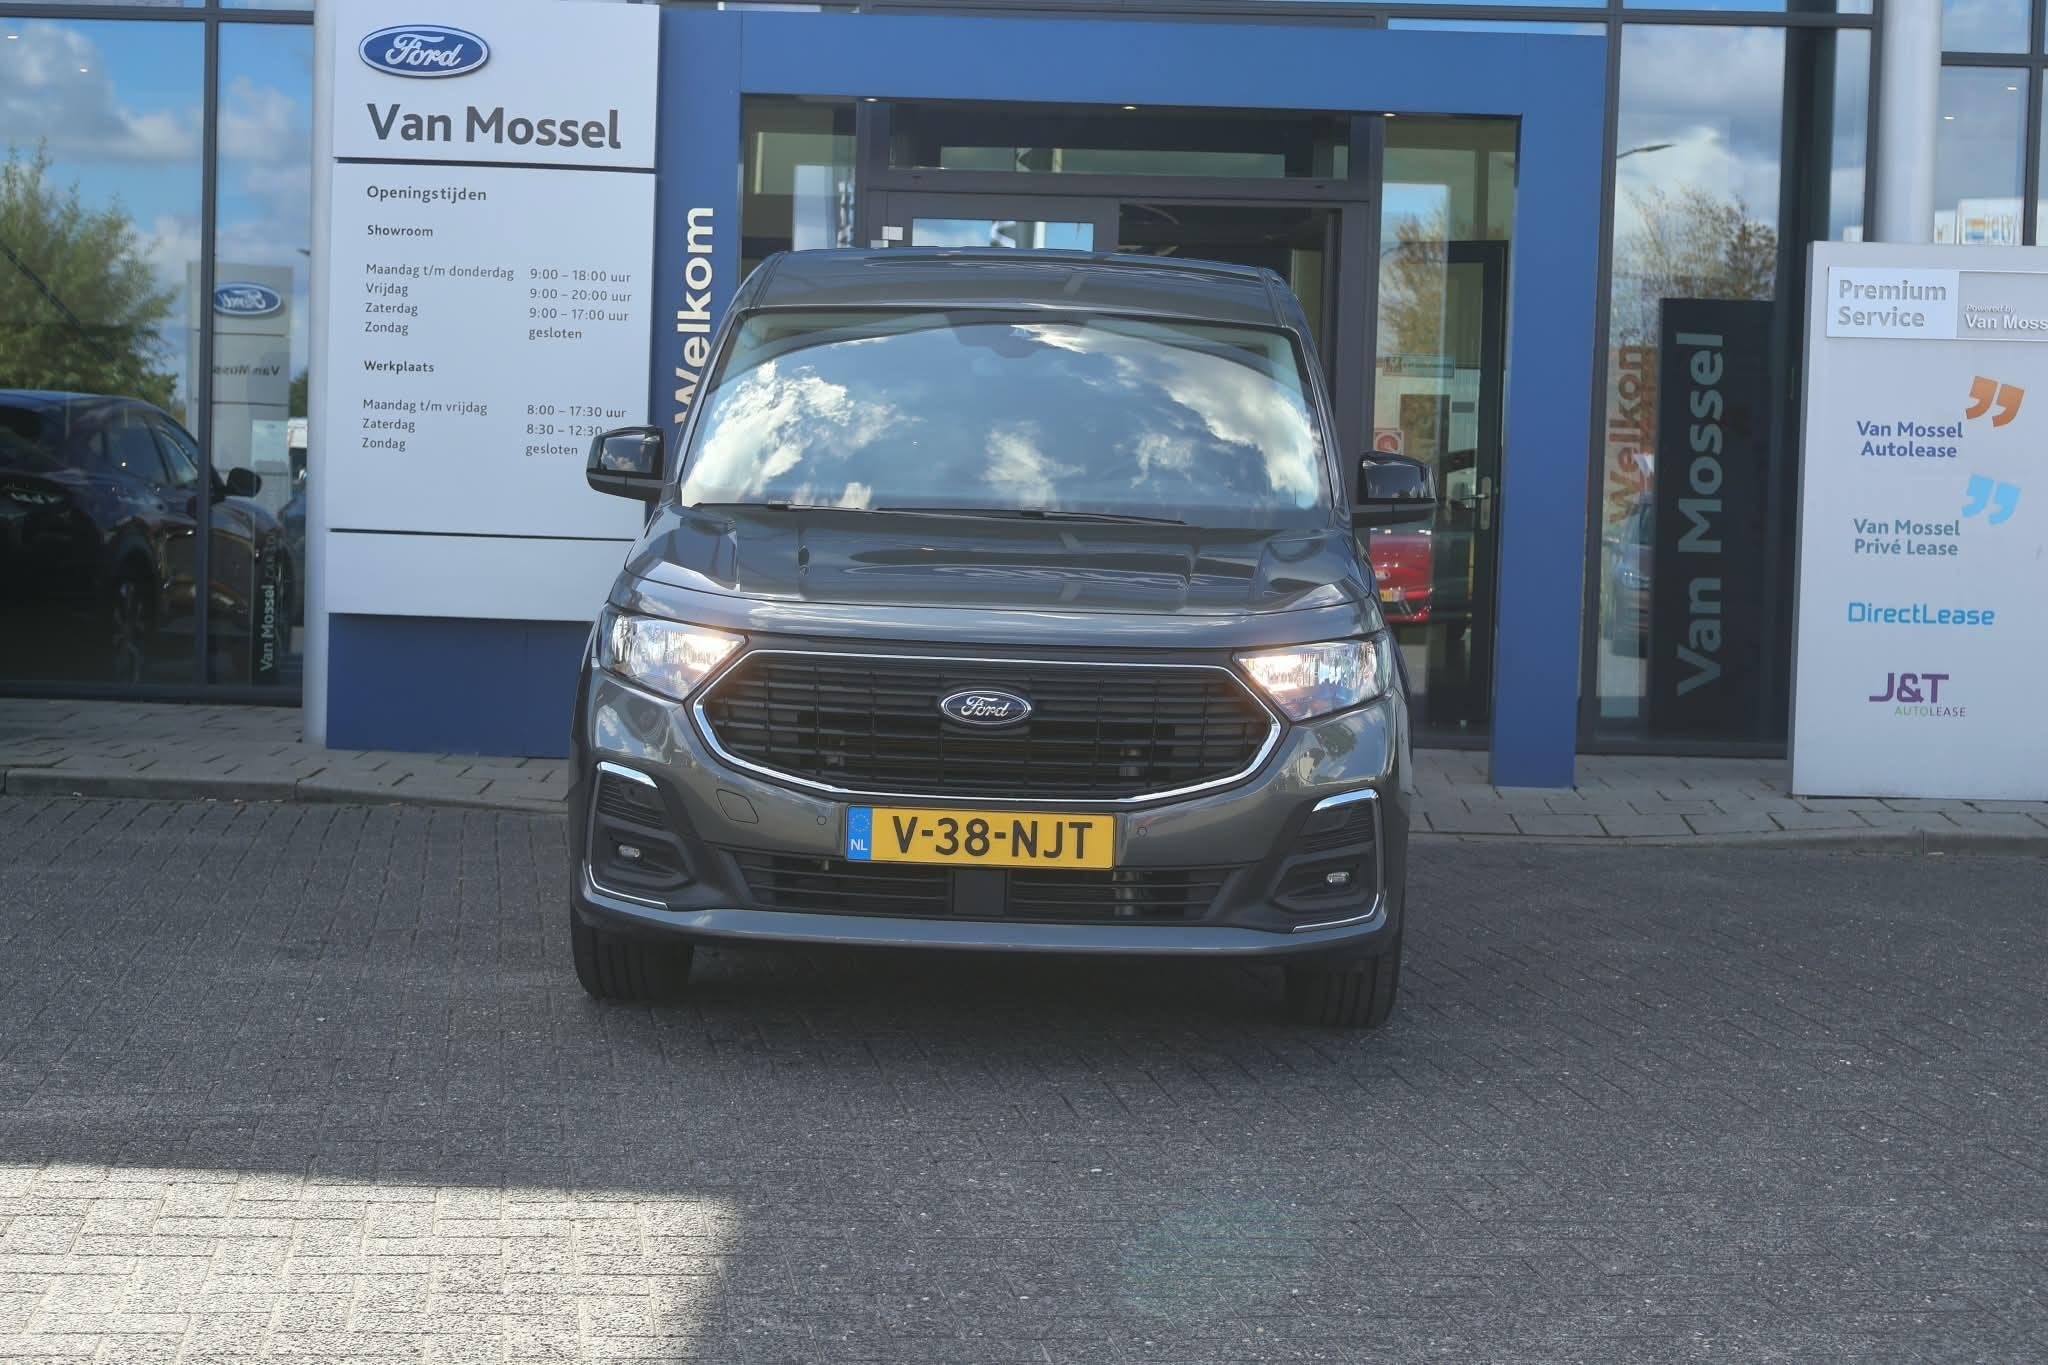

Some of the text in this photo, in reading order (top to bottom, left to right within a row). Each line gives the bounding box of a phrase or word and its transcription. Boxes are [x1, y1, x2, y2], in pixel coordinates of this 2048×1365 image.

[384, 33, 464, 66] Ford
[366, 103, 622, 149] Van Mossel
[366, 185, 487, 204] Openingstijden
[366, 224, 434, 237] Showroom
[365, 263, 420, 279] Maandag
[423, 265, 446, 277] t/m
[449, 266, 514, 282] donderdag
[530, 268, 559, 281] 9:00
[572, 269, 607, 283] 18:00
[611, 273, 632, 283] uur
[365, 283, 409, 298] Vrijdag
[529, 288, 558, 300] 9:00
[571, 290, 608, 302] 20:00
[611, 292, 632, 303] uur
[1838, 279, 1947, 301] Premium
[365, 302, 419, 317] Zaterdag
[528, 307, 557, 320] 9:00
[570, 308, 605, 322] 17:00
[608, 312, 630, 322] uur
[1837, 305, 1926, 328] Service
[1965, 313, 2048, 330] Van Moss
[364, 321, 582, 341] Zondag gesloten
[363, 360, 435, 375] Werkplaats
[362, 399, 416, 414] Maandag
[420, 401, 443, 412] t/m
[446, 402, 488, 417] vrijdag
[527, 404, 555, 416] 8:00
[569, 406, 602, 418] 17:30
[606, 409, 627, 419] uur
[362, 418, 416, 433] Zaterdag
[526, 423, 555, 435] 8:30
[568, 425, 603, 437] 12:30
[1856, 420, 1964, 439] Van Mossel
[361, 437, 578, 457] Zondag gesloten
[1860, 441, 1958, 458] Autolease
[1675, 332, 1724, 697] Van Mossel
[1853, 518, 1961, 536] Van Mossel
[1853, 538, 1959, 556] Privé Lease
[261, 585, 275, 638] Mossel
[1847, 602, 1995, 626] DirectLease
[260, 642, 274, 671] Van
[1868, 672, 1950, 703] J&T
[960, 695, 1010, 718] Ford
[1893, 705, 1967, 718] AUTOLEASE
[850, 815, 1094, 860] NL V-38-NJT
